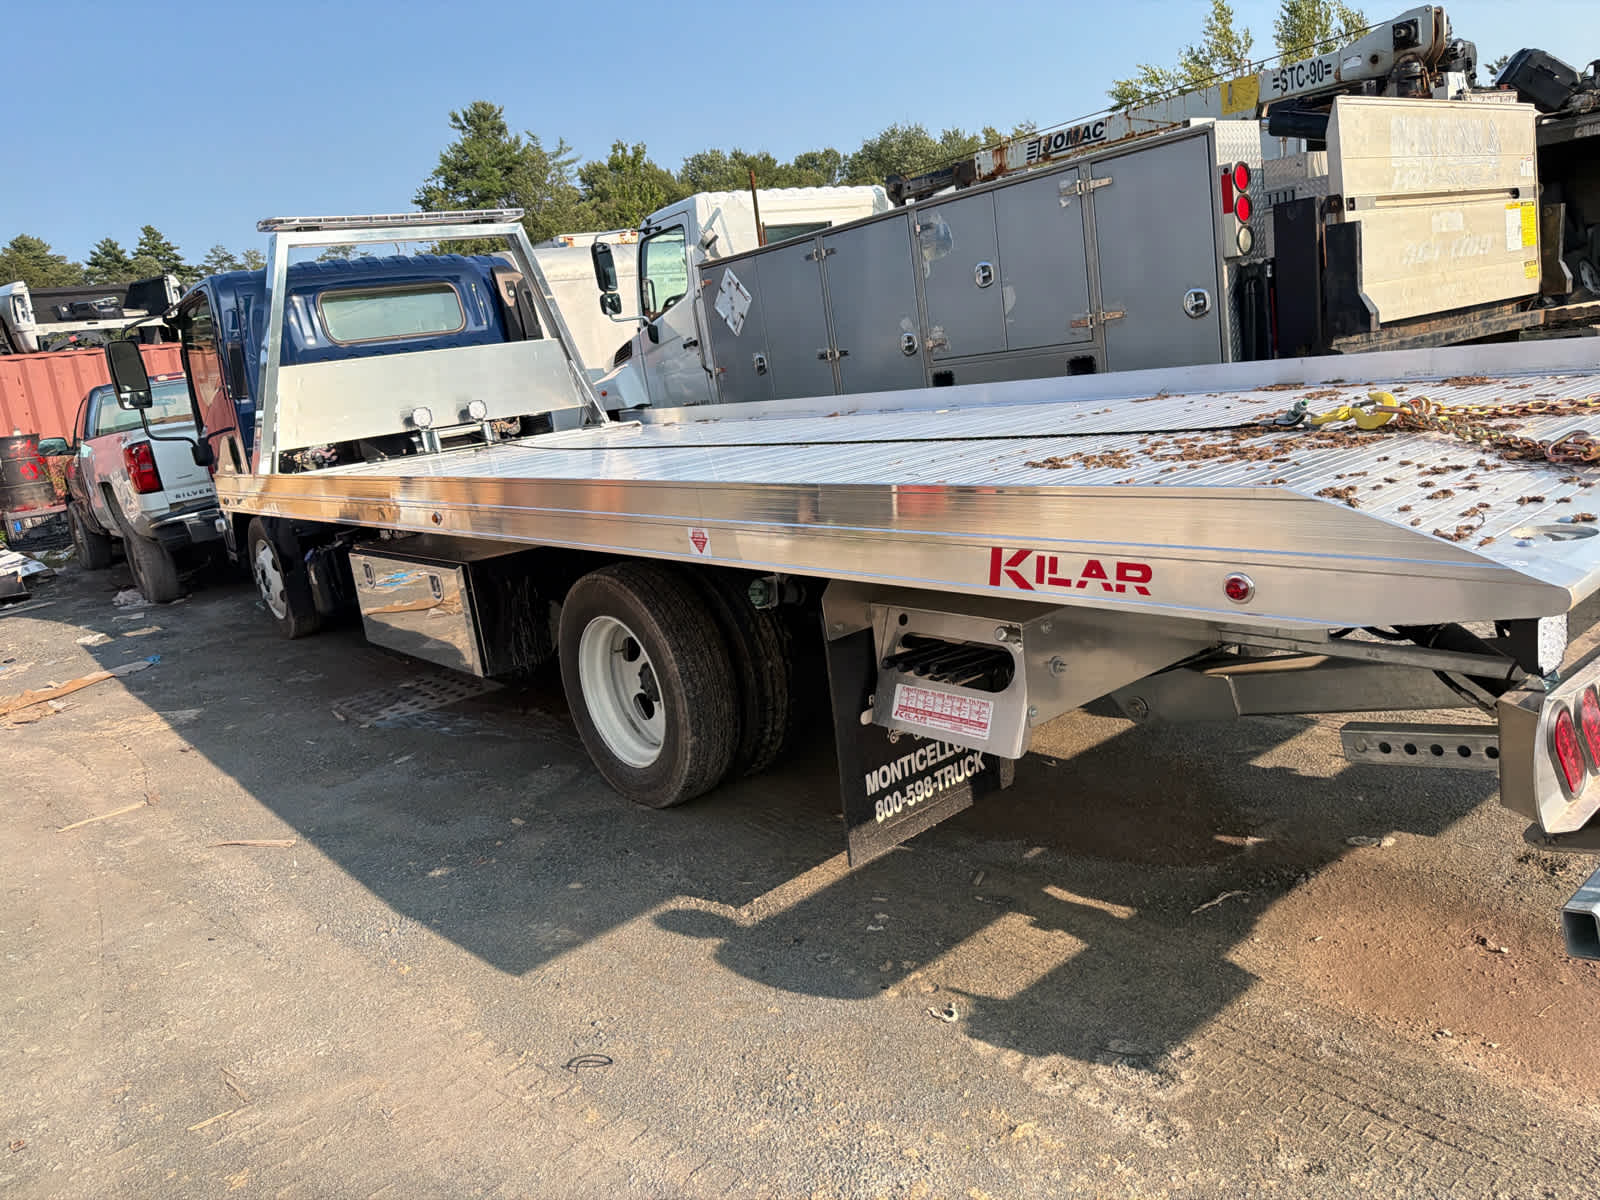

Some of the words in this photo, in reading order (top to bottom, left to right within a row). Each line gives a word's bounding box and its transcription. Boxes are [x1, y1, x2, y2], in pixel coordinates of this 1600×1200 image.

[1043, 121, 1105, 152] JOMAC
[989, 547, 1153, 596] KILAR
[894, 710, 928, 725] KILAR
[875, 752, 985, 824] 800-598-TRUCK
